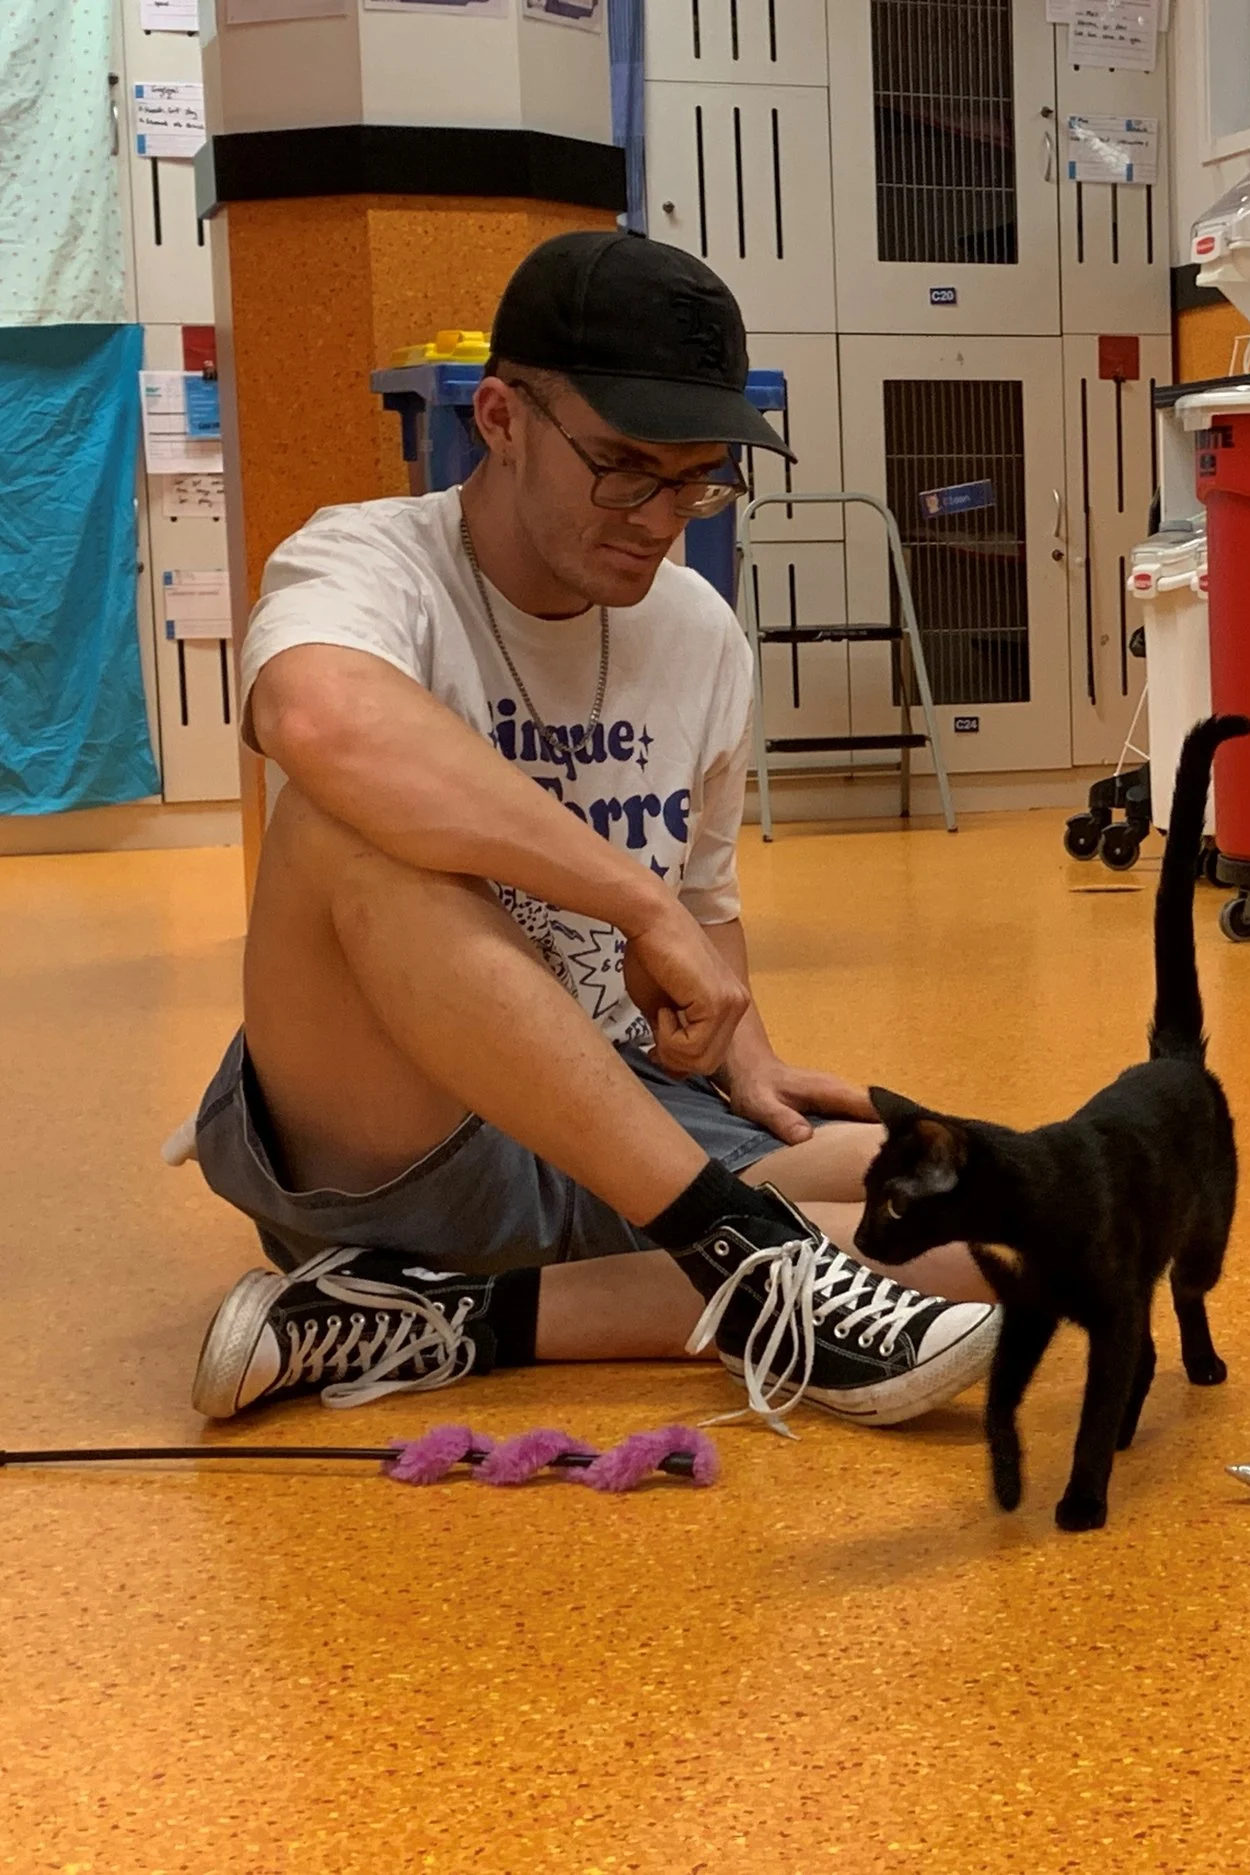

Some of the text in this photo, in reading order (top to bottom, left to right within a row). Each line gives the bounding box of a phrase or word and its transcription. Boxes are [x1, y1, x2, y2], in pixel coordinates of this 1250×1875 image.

[931, 290, 955, 302] C20
[956, 719, 978, 730] C24
[487, 698, 634, 781] inque
